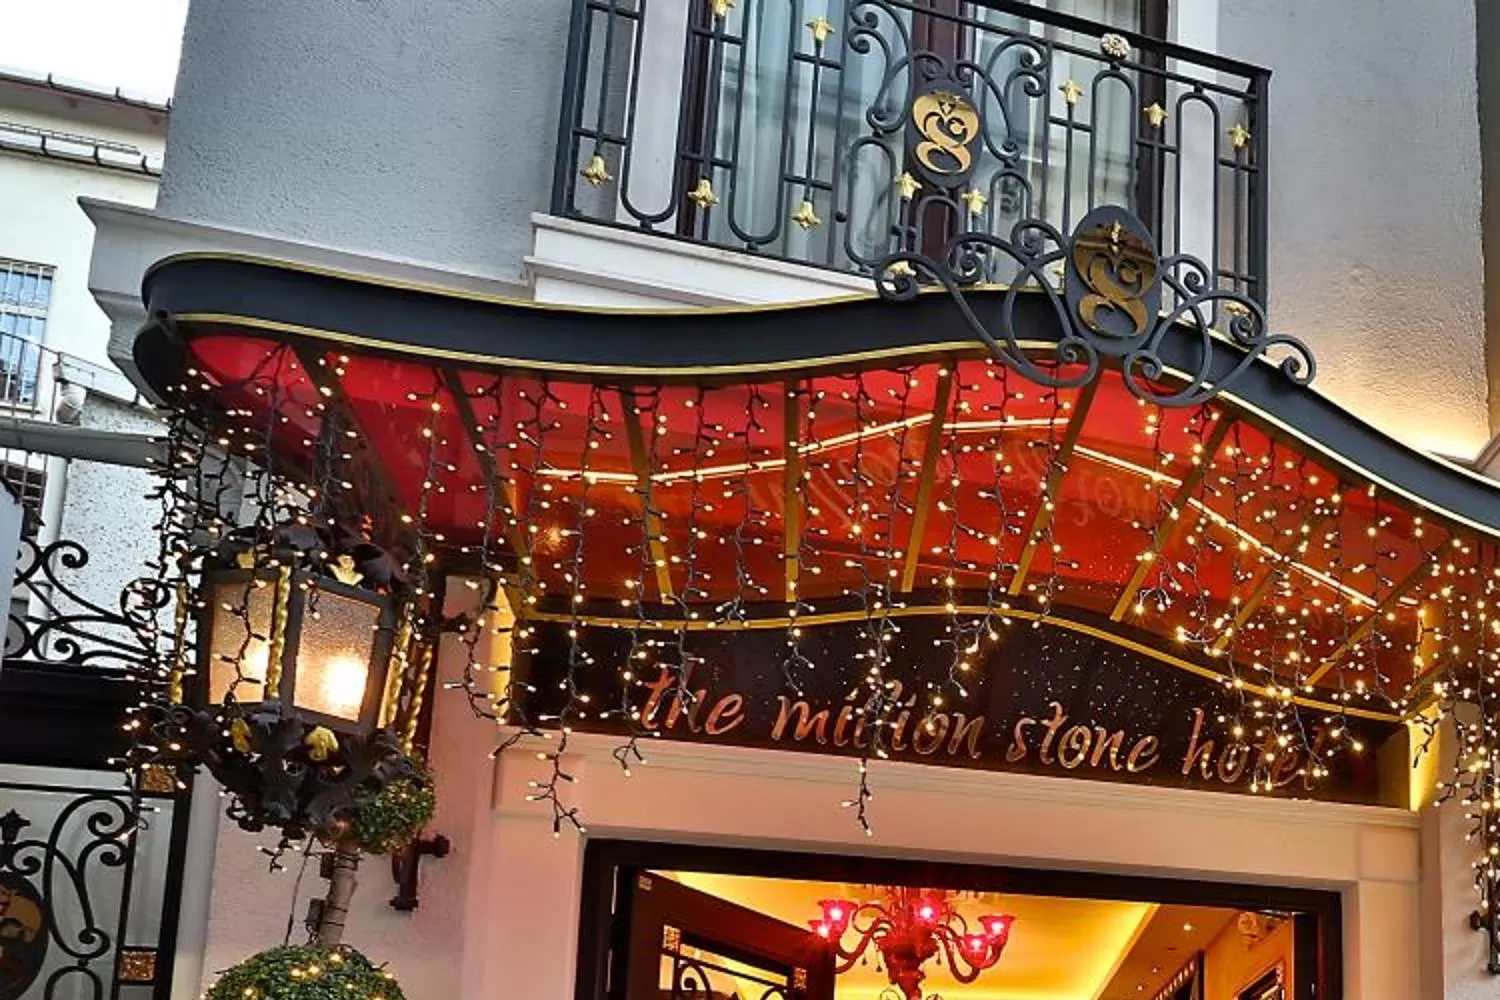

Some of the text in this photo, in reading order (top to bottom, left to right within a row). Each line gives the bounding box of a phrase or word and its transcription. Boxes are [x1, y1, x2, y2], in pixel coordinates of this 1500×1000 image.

[641, 661, 746, 735] the
[1005, 700, 1160, 773] stone
[1181, 706, 1327, 791] hotel
